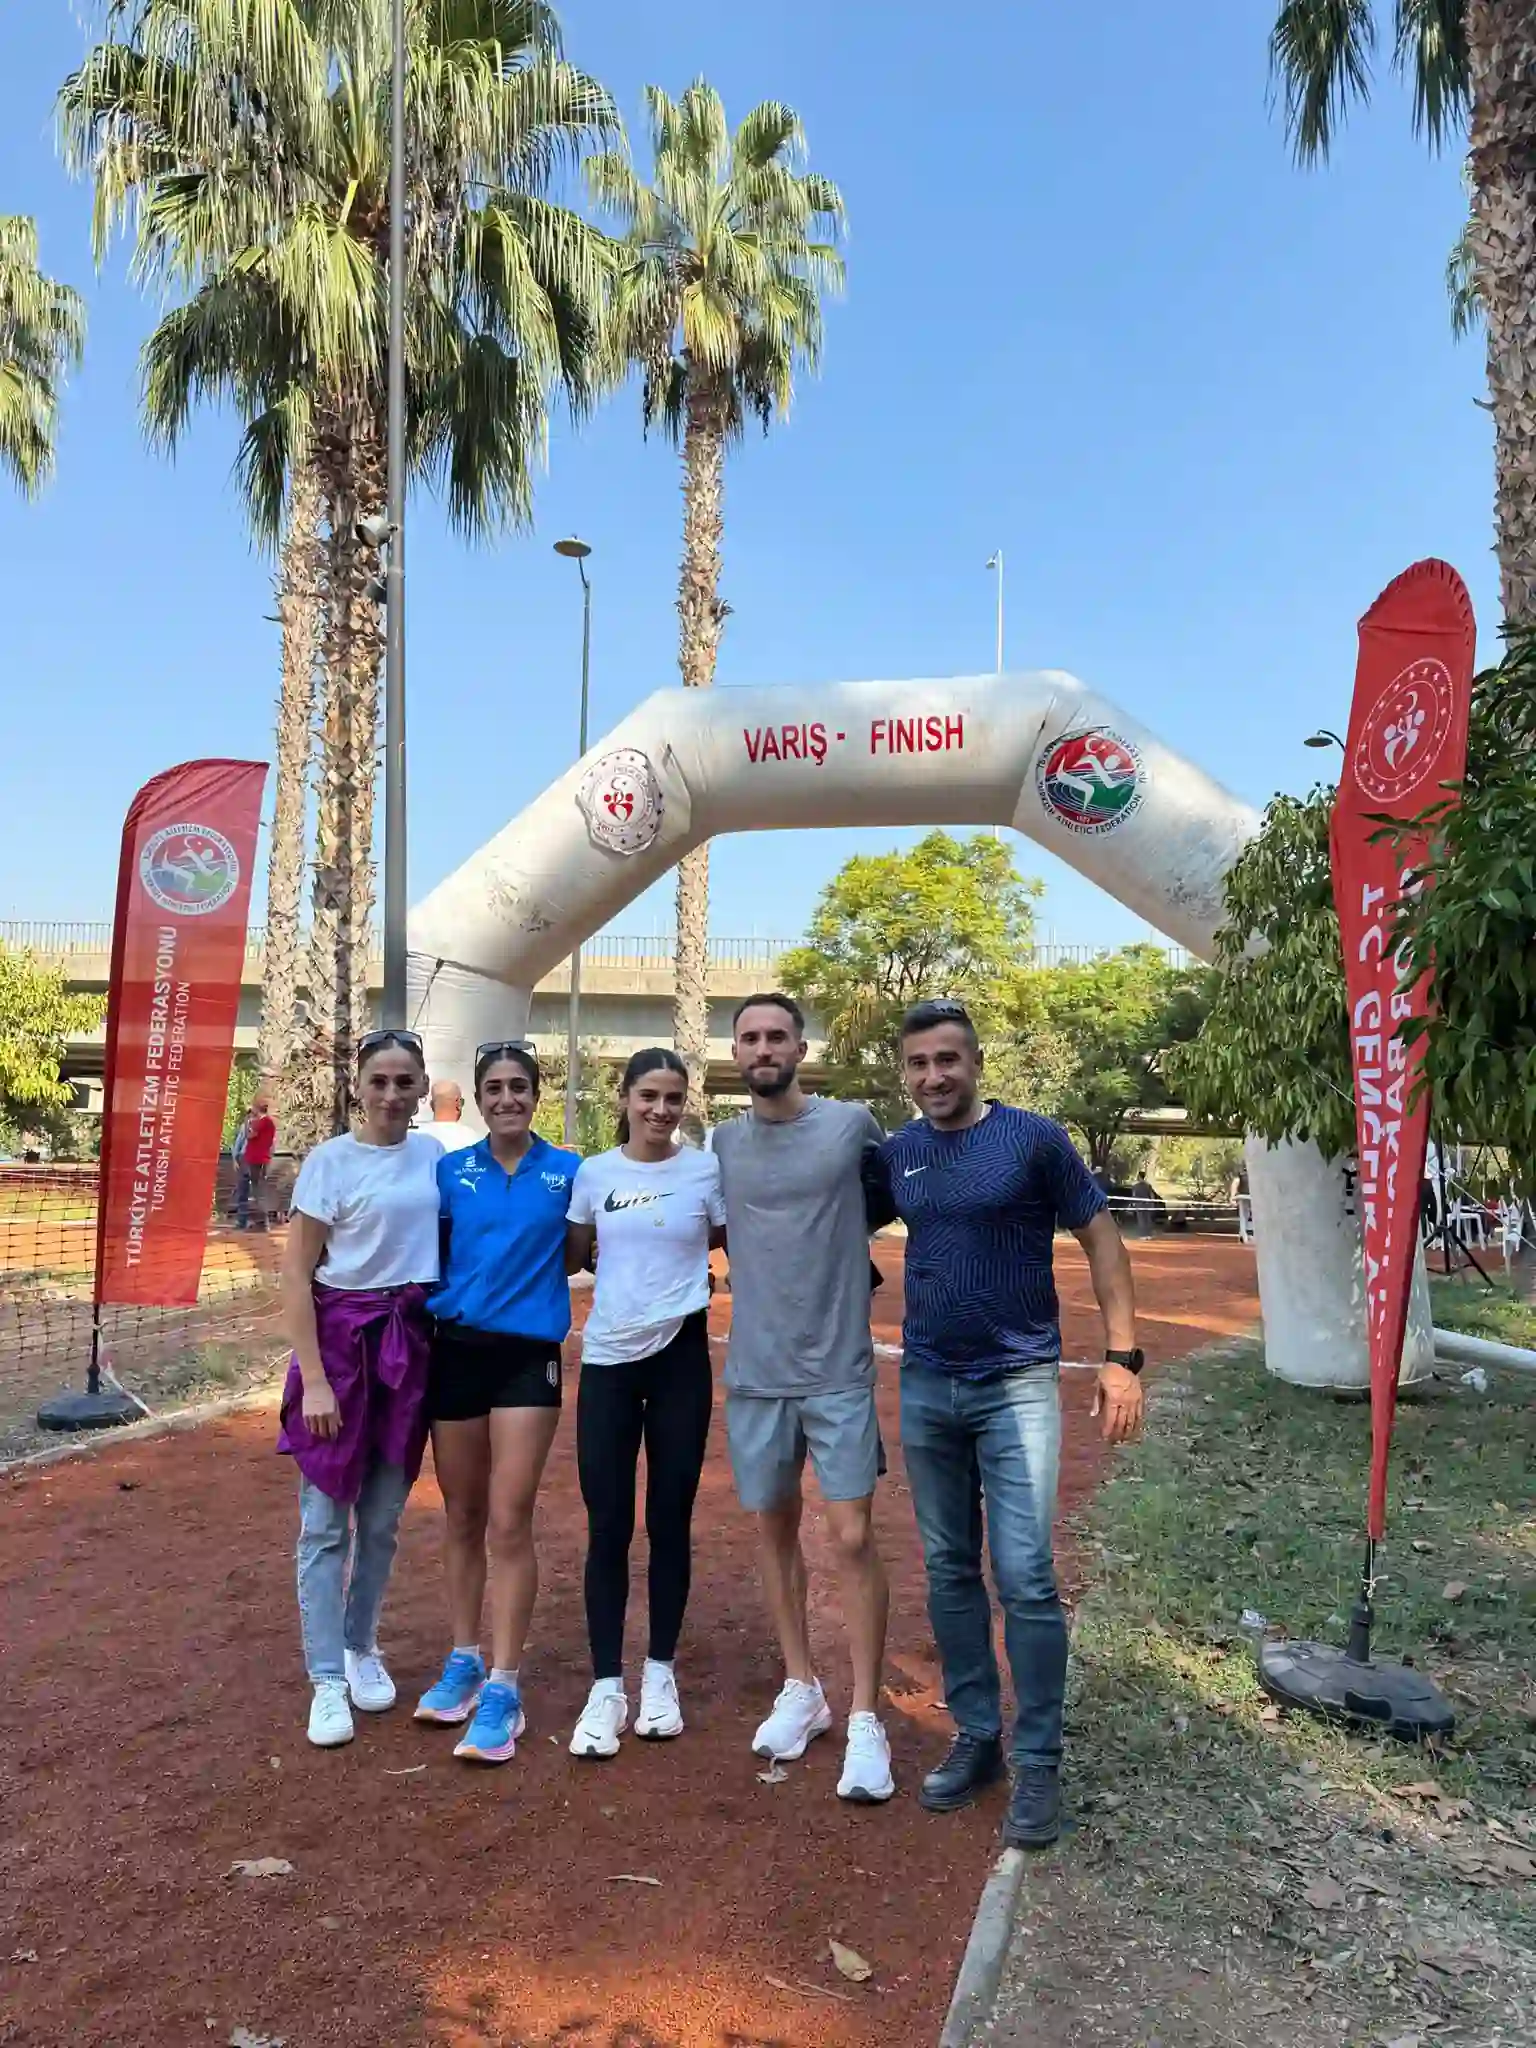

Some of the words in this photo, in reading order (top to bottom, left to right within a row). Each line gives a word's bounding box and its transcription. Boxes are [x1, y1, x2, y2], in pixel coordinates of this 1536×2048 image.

[744, 722, 828, 766] VARIŞ
[871, 714, 964, 754] FINISH
[146, 926, 178, 1071] FEDERASYONU
[168, 981, 191, 1071] FEDERATION
[136, 1074, 161, 1177] ATLETİZM
[160, 1074, 181, 1145] ATHLETIC
[126, 1181, 149, 1268] TÜRKİYE
[151, 1149, 172, 1213] TURKISH
